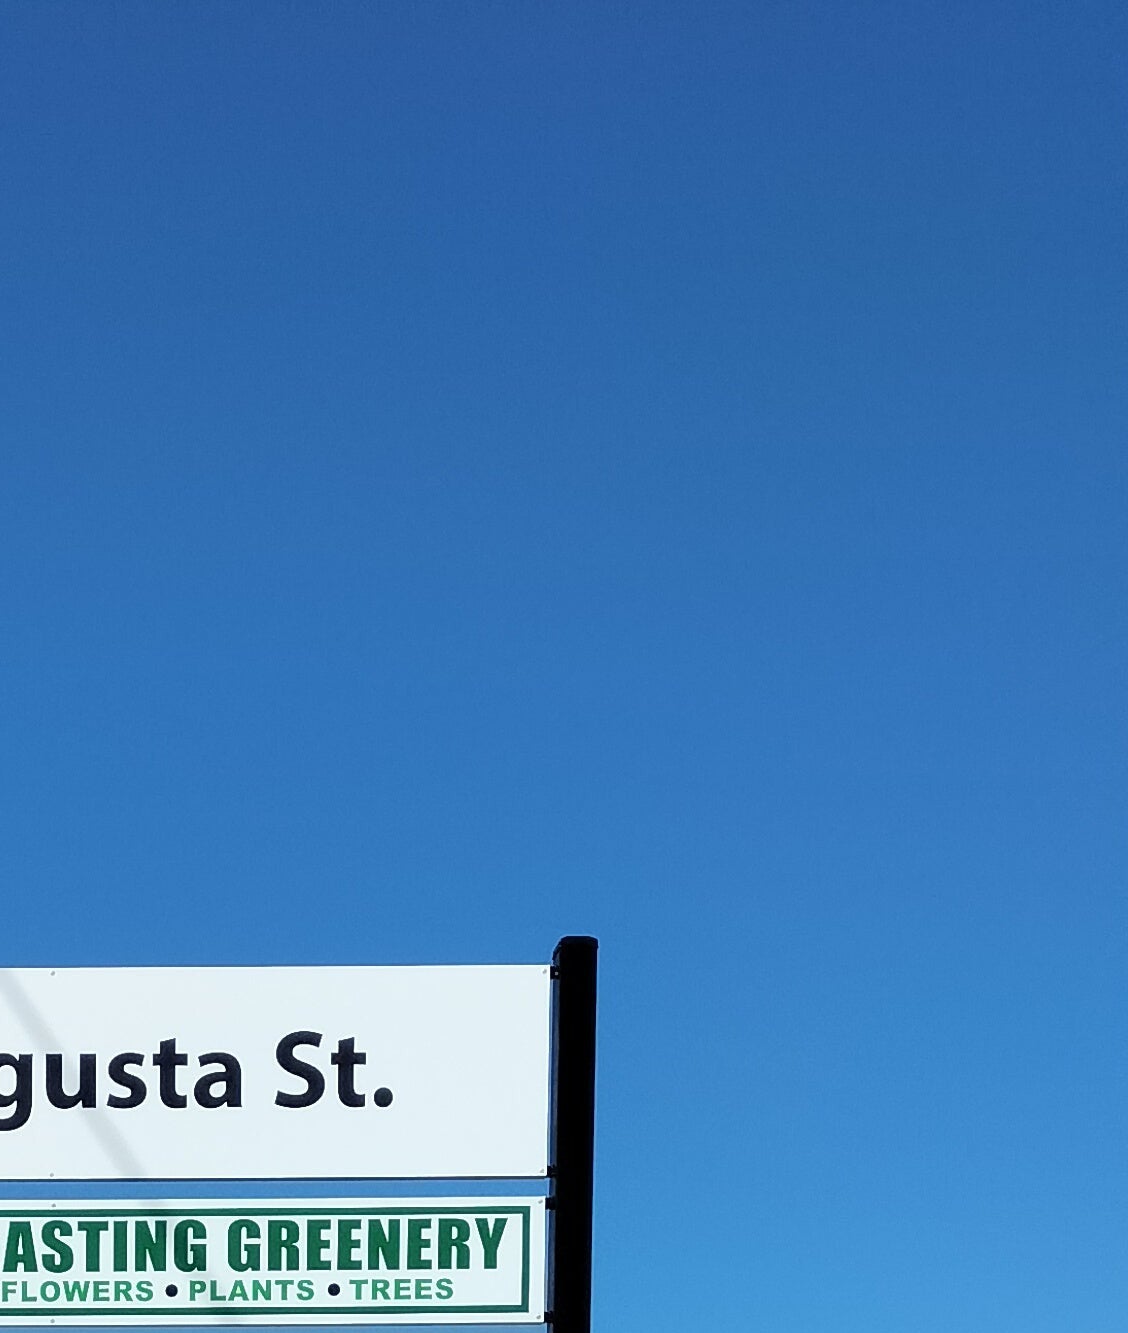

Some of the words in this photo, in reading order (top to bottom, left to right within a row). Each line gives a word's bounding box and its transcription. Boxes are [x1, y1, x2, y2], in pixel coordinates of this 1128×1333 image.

[274, 1030, 394, 1109] St.
[228, 1217, 508, 1272] GREENERY
[1, 1280, 154, 1303] FLOWERS
[188, 1279, 315, 1303] PLANTS
[349, 1277, 455, 1301] TREES
